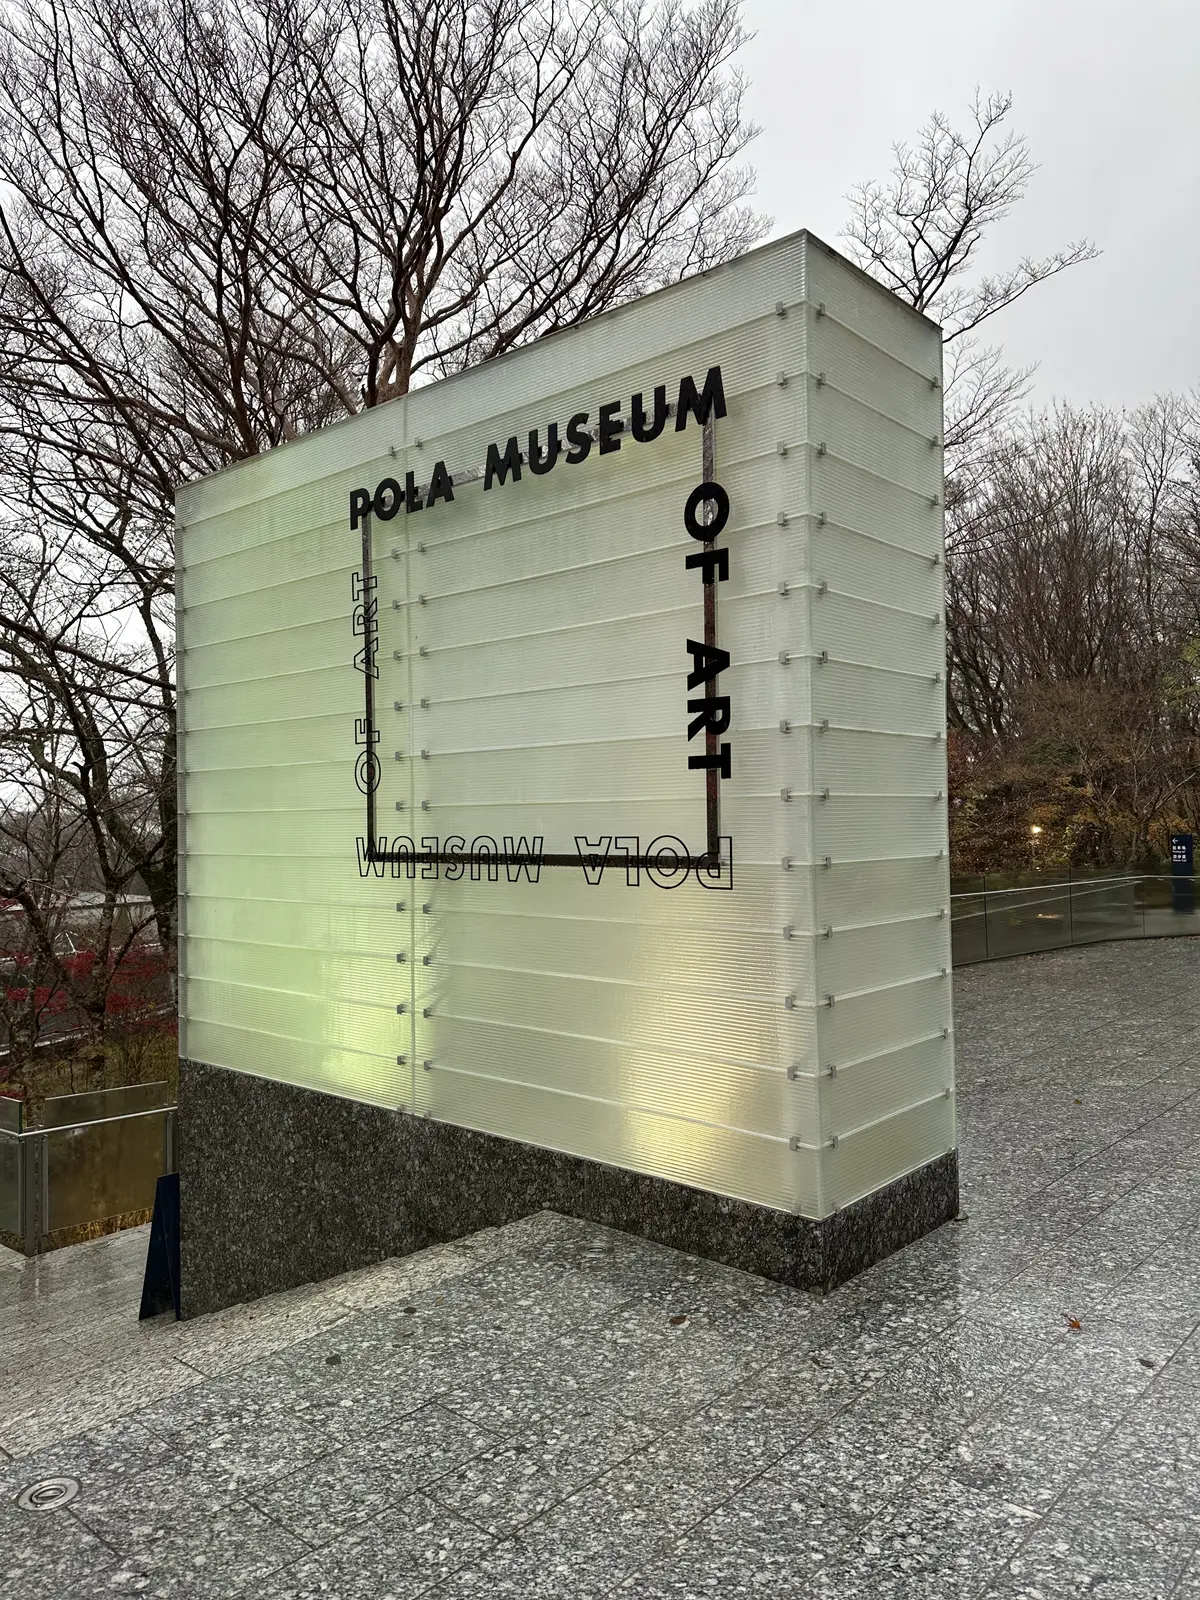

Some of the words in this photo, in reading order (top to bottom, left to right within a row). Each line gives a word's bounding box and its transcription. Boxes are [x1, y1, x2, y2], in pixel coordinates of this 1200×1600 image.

[350, 460, 455, 530] POLA
[484, 365, 727, 491] MUSEUM
[684, 481, 730, 584] OF
[352, 572, 379, 680] ART
[354, 718, 381, 795] OF
[686, 638, 731, 779] ART
[355, 835, 543, 883] MUSEUM
[574, 834, 733, 890] POLA
